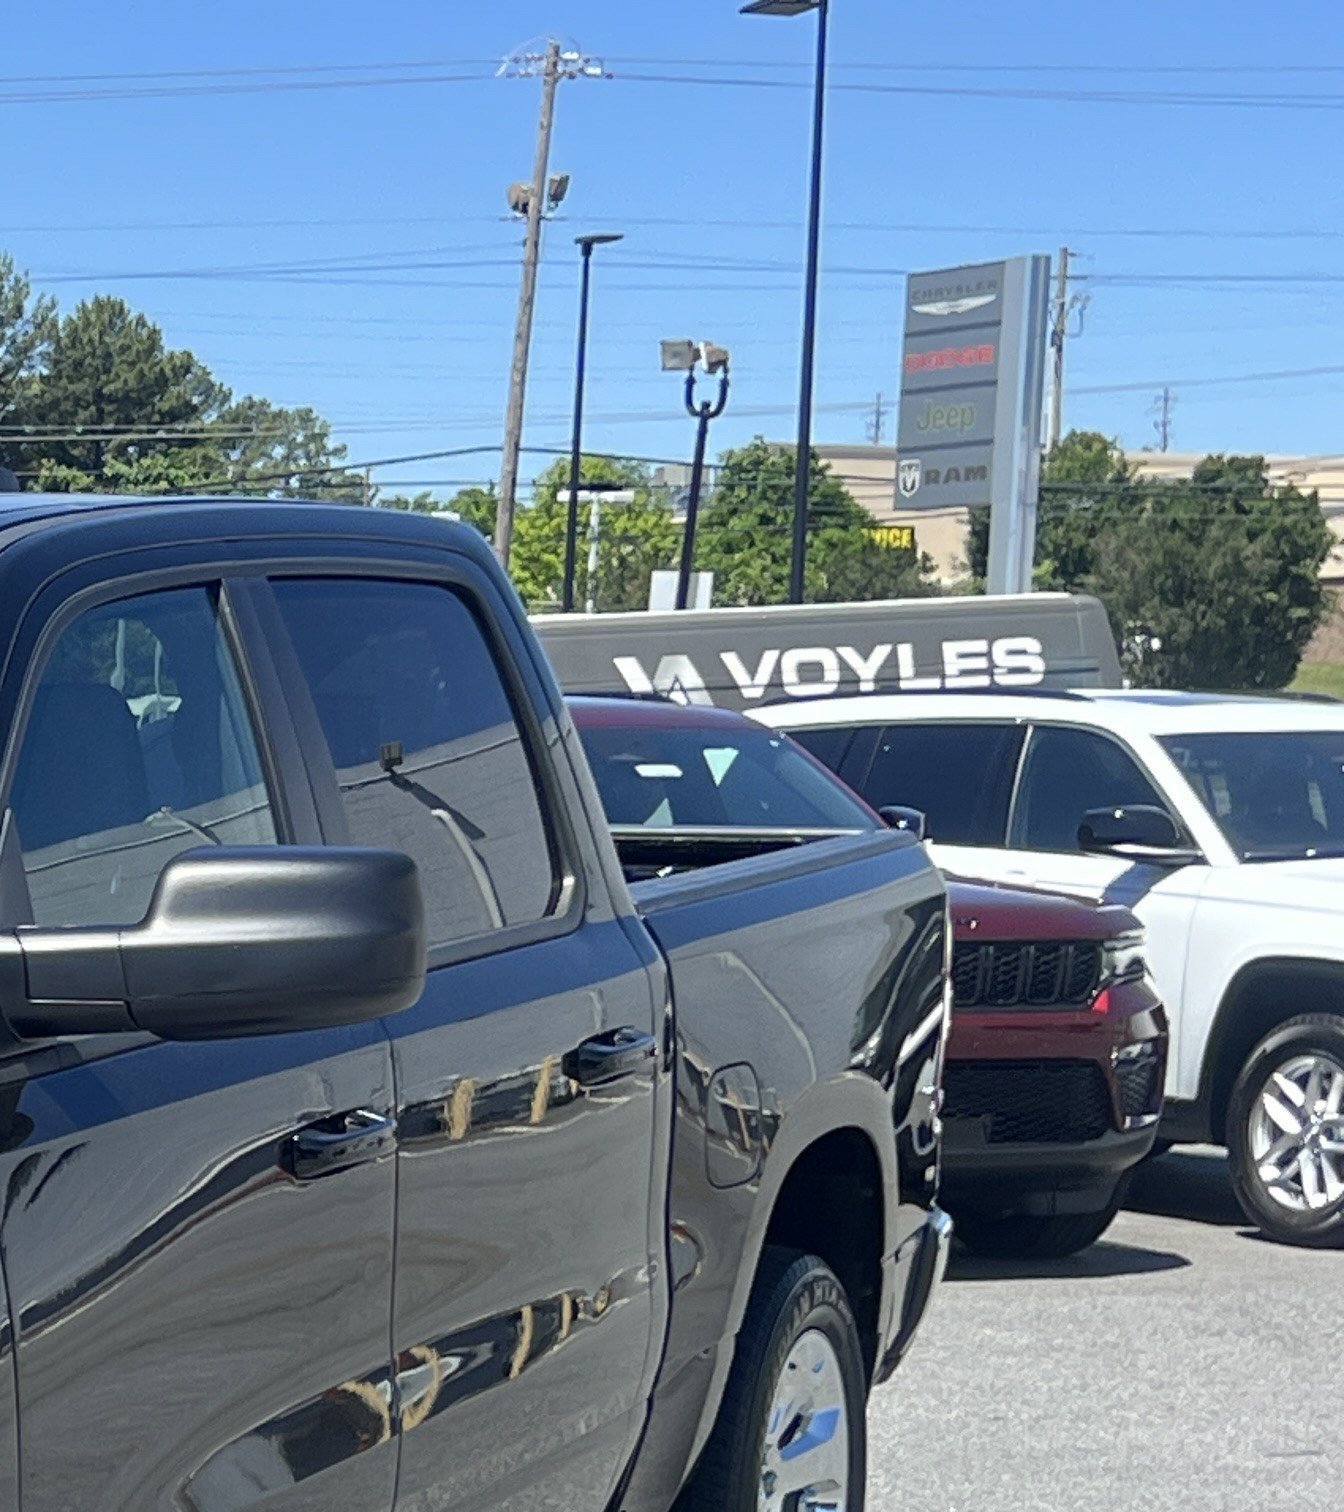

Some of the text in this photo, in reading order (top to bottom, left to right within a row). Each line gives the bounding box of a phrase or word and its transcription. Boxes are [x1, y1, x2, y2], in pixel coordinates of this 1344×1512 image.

[916, 401, 975, 433] Jeep
[924, 465, 988, 485] RAM
[720, 637, 1046, 698] VOYLES
